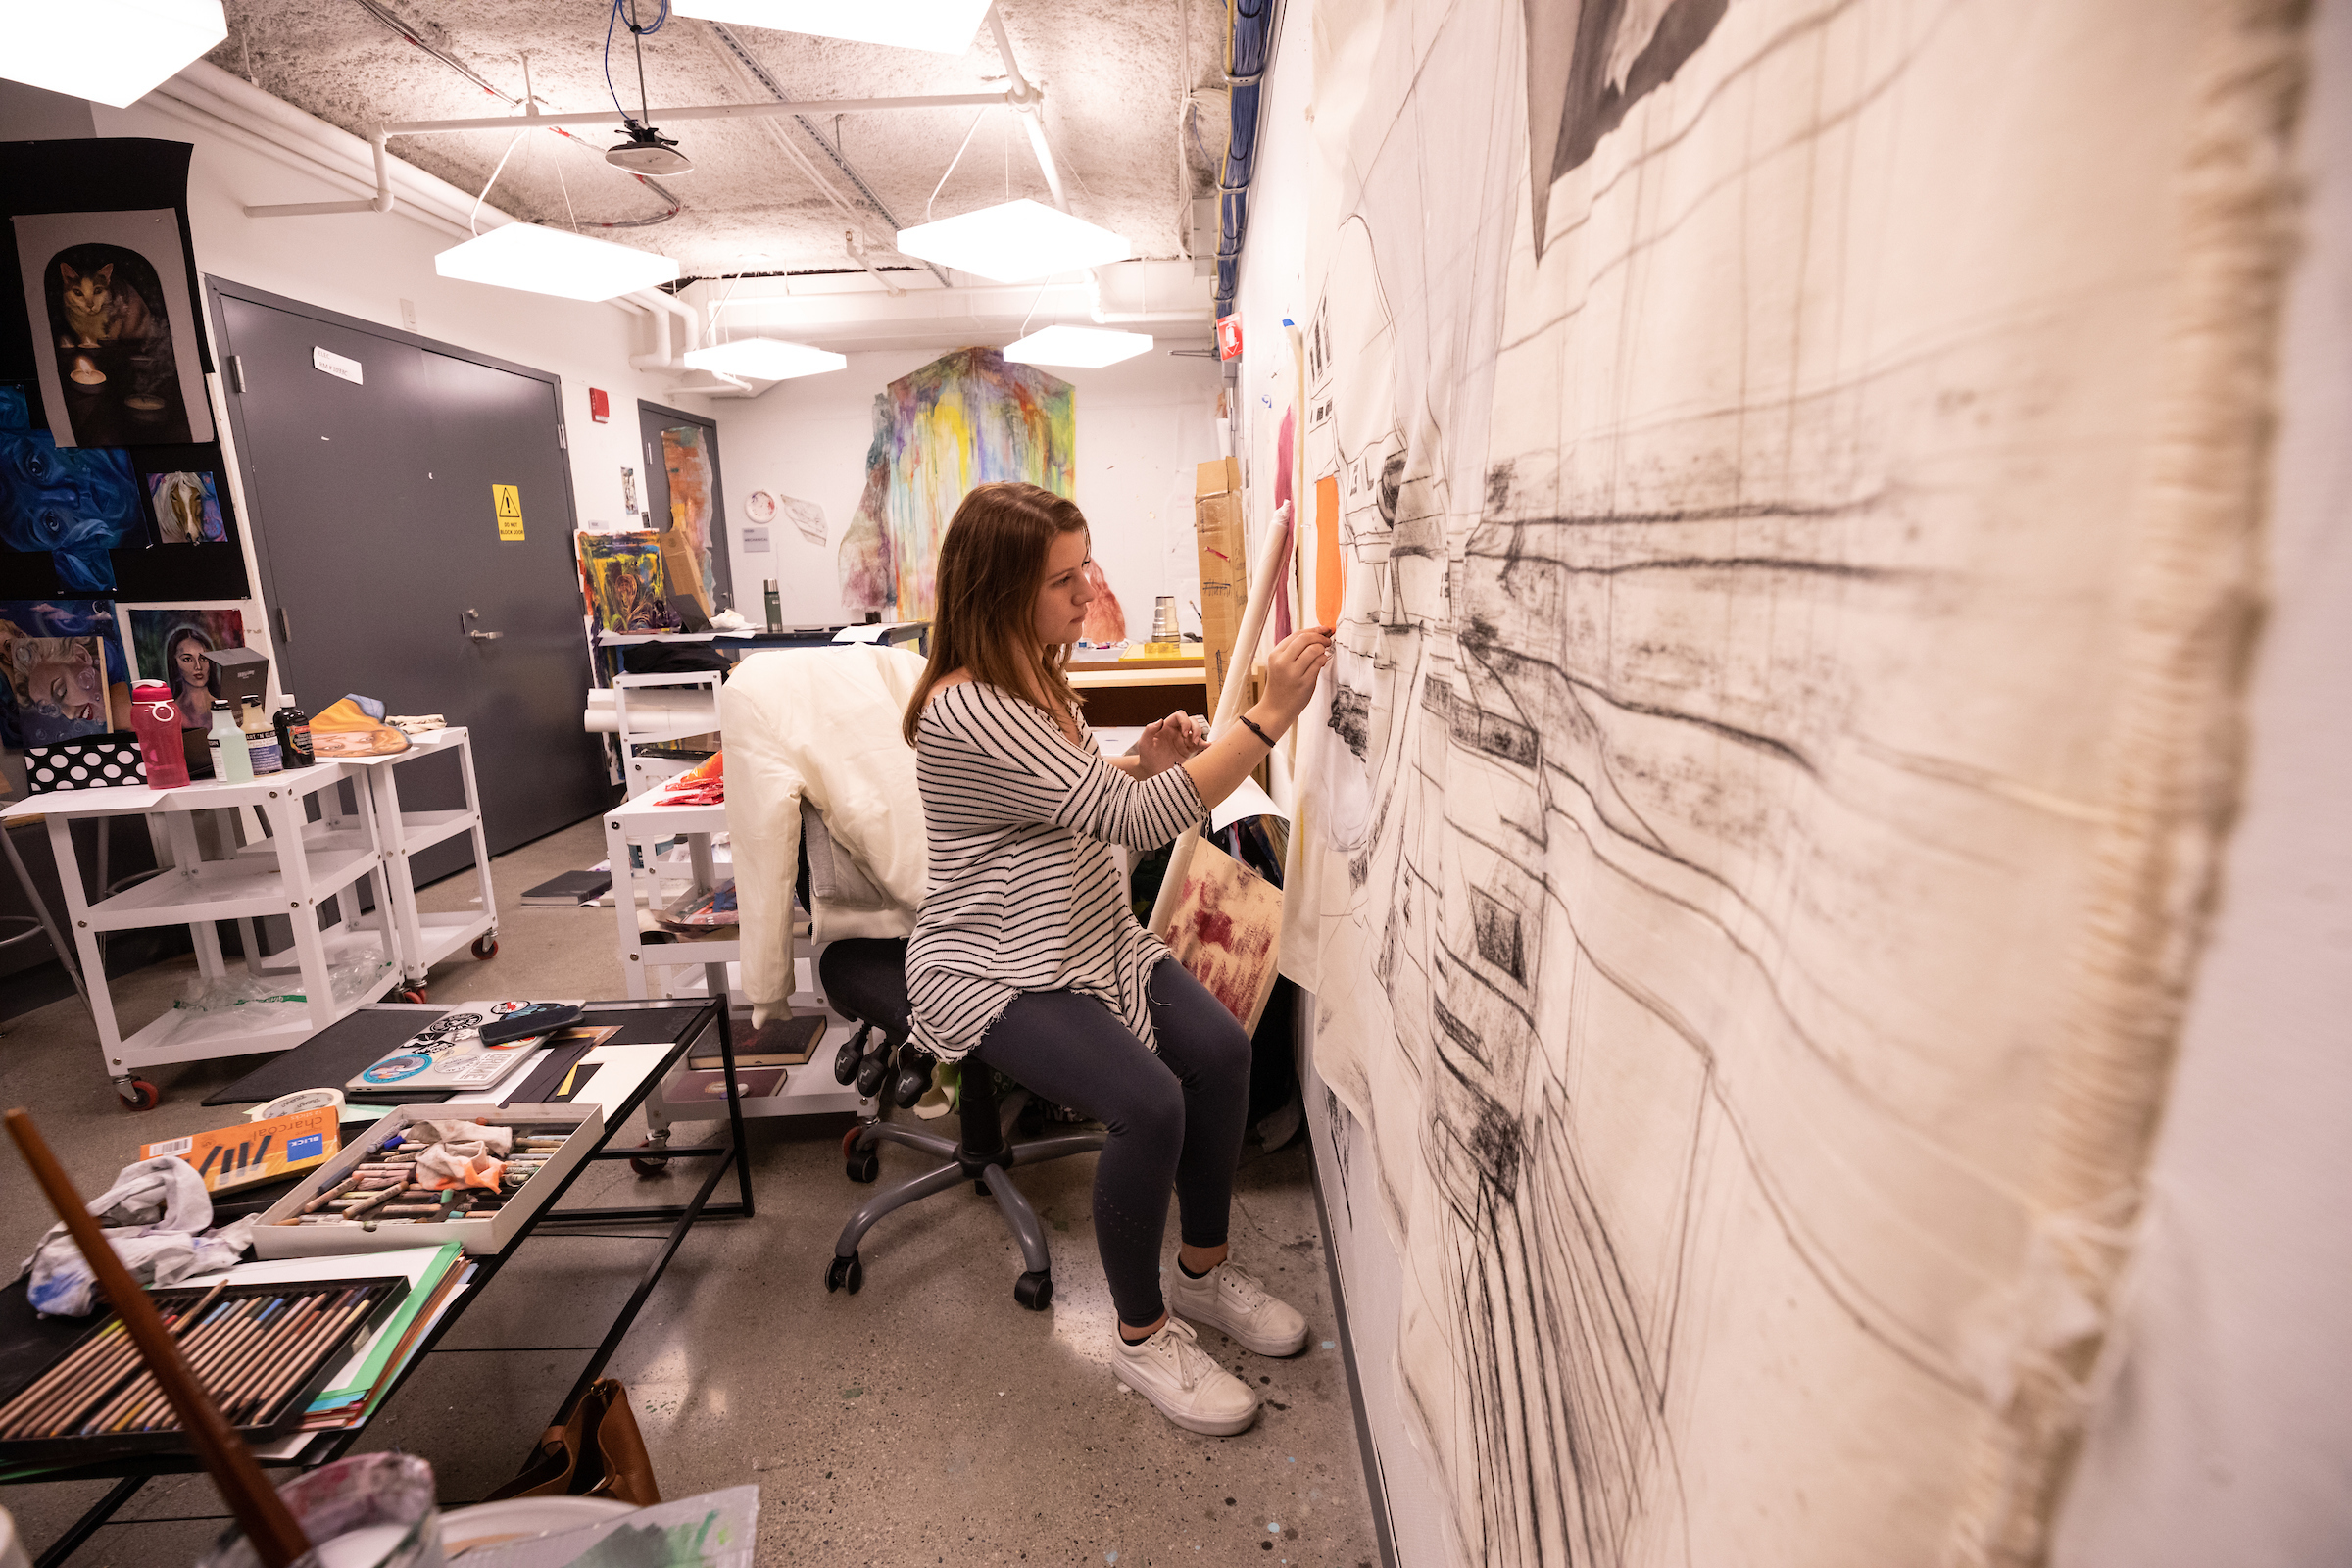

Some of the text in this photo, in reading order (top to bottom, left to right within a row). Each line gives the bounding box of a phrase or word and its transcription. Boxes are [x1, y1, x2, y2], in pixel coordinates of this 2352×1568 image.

[318, 350, 330, 360] ELEC
[253, 1116, 323, 1141] charcoal
[291, 1136, 319, 1147] BLICK
